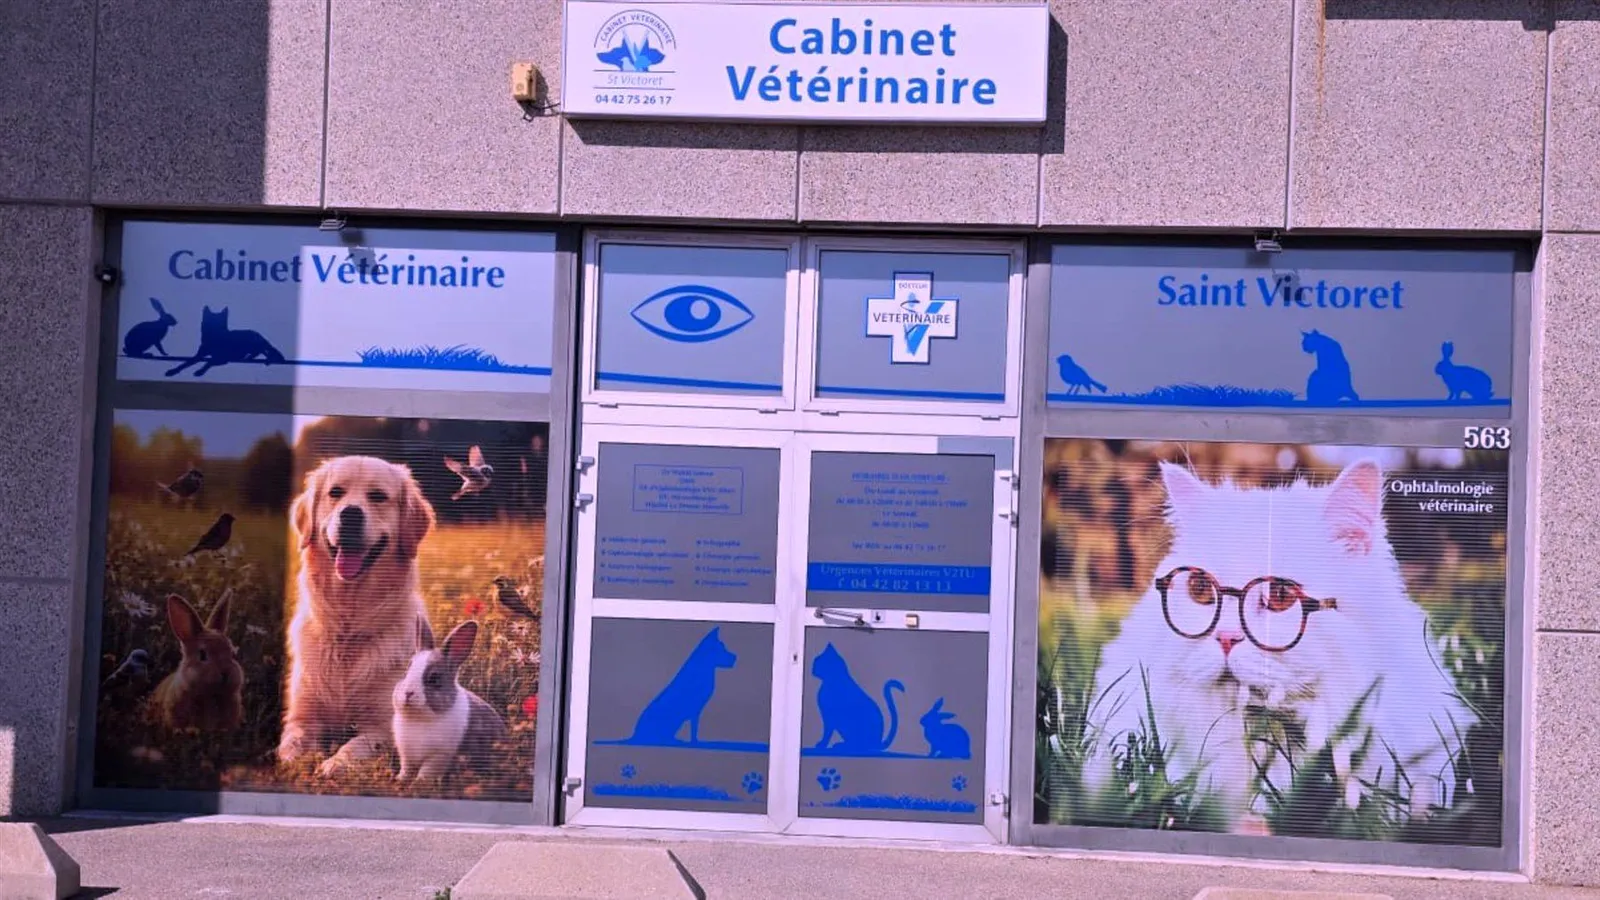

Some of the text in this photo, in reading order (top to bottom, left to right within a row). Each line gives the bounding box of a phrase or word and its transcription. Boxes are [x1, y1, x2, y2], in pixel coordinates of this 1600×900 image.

[769, 17, 957, 57] Cabinet
[726, 64, 997, 105] Vétérinaire
[595, 94, 672, 105] 04 42 75 26 17
[168, 249, 506, 289] Cabinet Vétérinaire
[1157, 273, 1405, 310] Saint Victoret
[1463, 426, 1511, 449] 563
[1391, 479, 1494, 499] Ophtalmologie
[1419, 499, 1494, 514] vétérinaire
[820, 563, 872, 577] Urgences
[851, 578, 867, 589] 04
[872, 578, 888, 590] 42
[915, 580, 930, 591] 13
